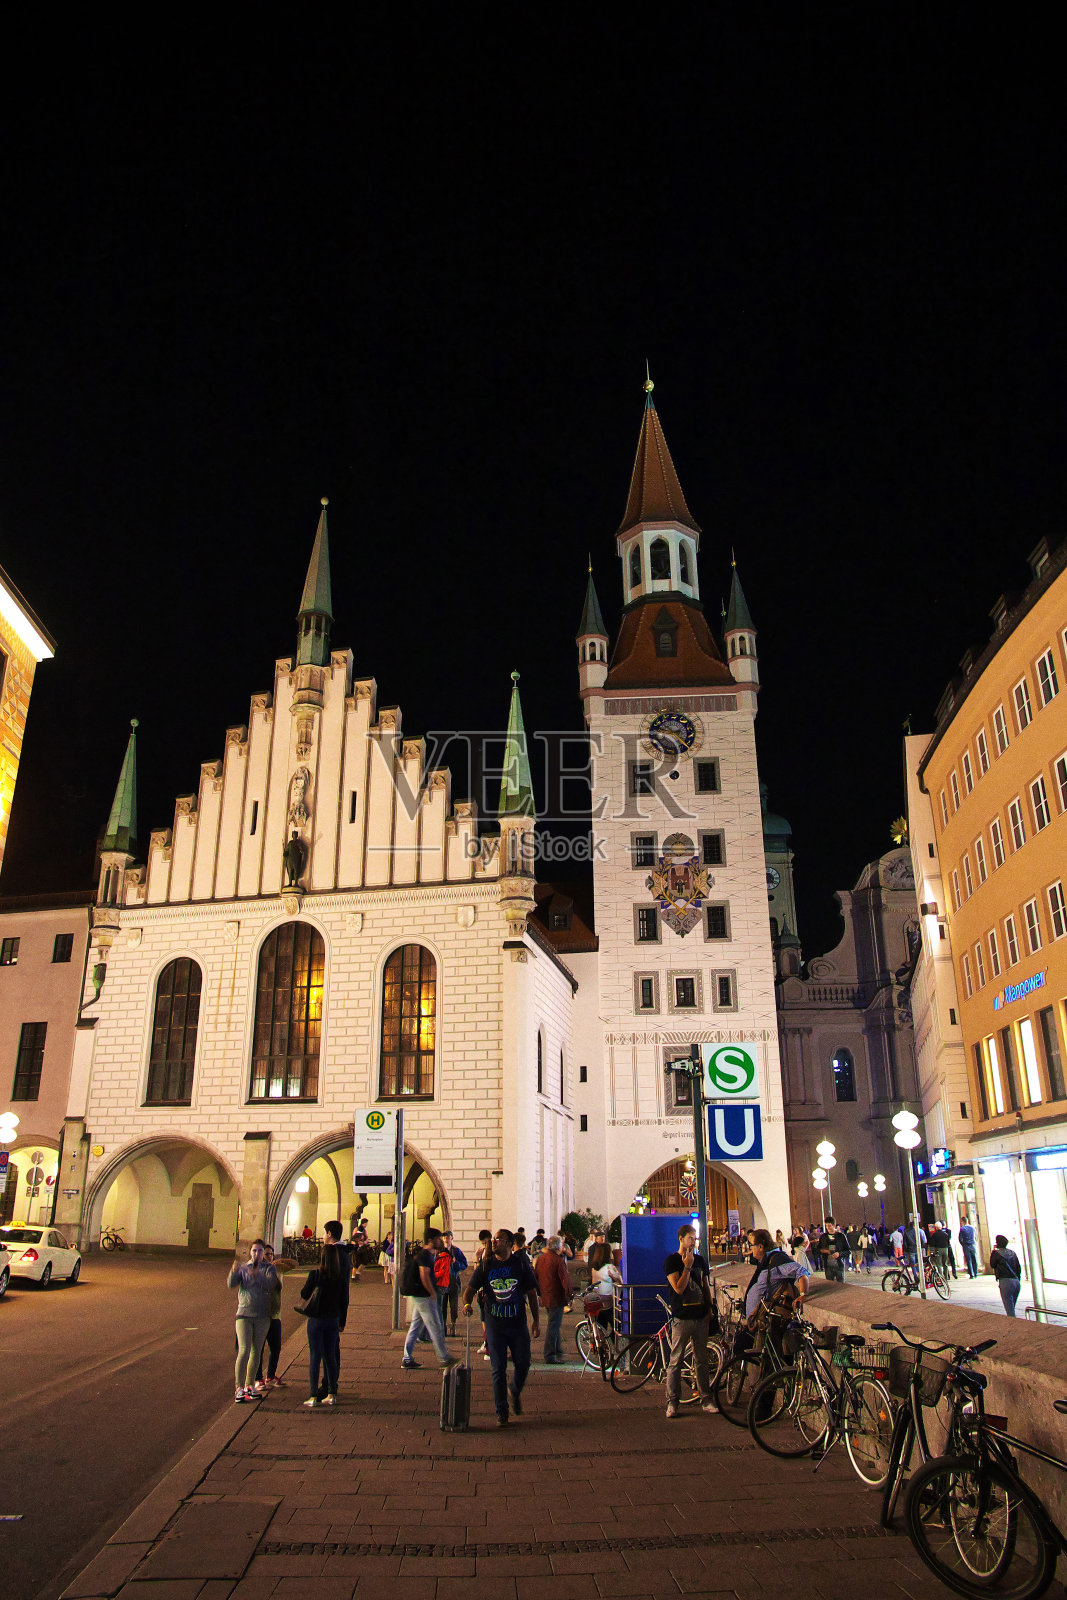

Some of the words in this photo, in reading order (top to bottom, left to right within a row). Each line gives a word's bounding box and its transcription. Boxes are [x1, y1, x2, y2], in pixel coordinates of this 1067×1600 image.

[1004, 971, 1044, 1003] Manpower
[715, 1049, 748, 1090] S
[370, 1115, 381, 1126] H
[714, 1108, 755, 1156] U
